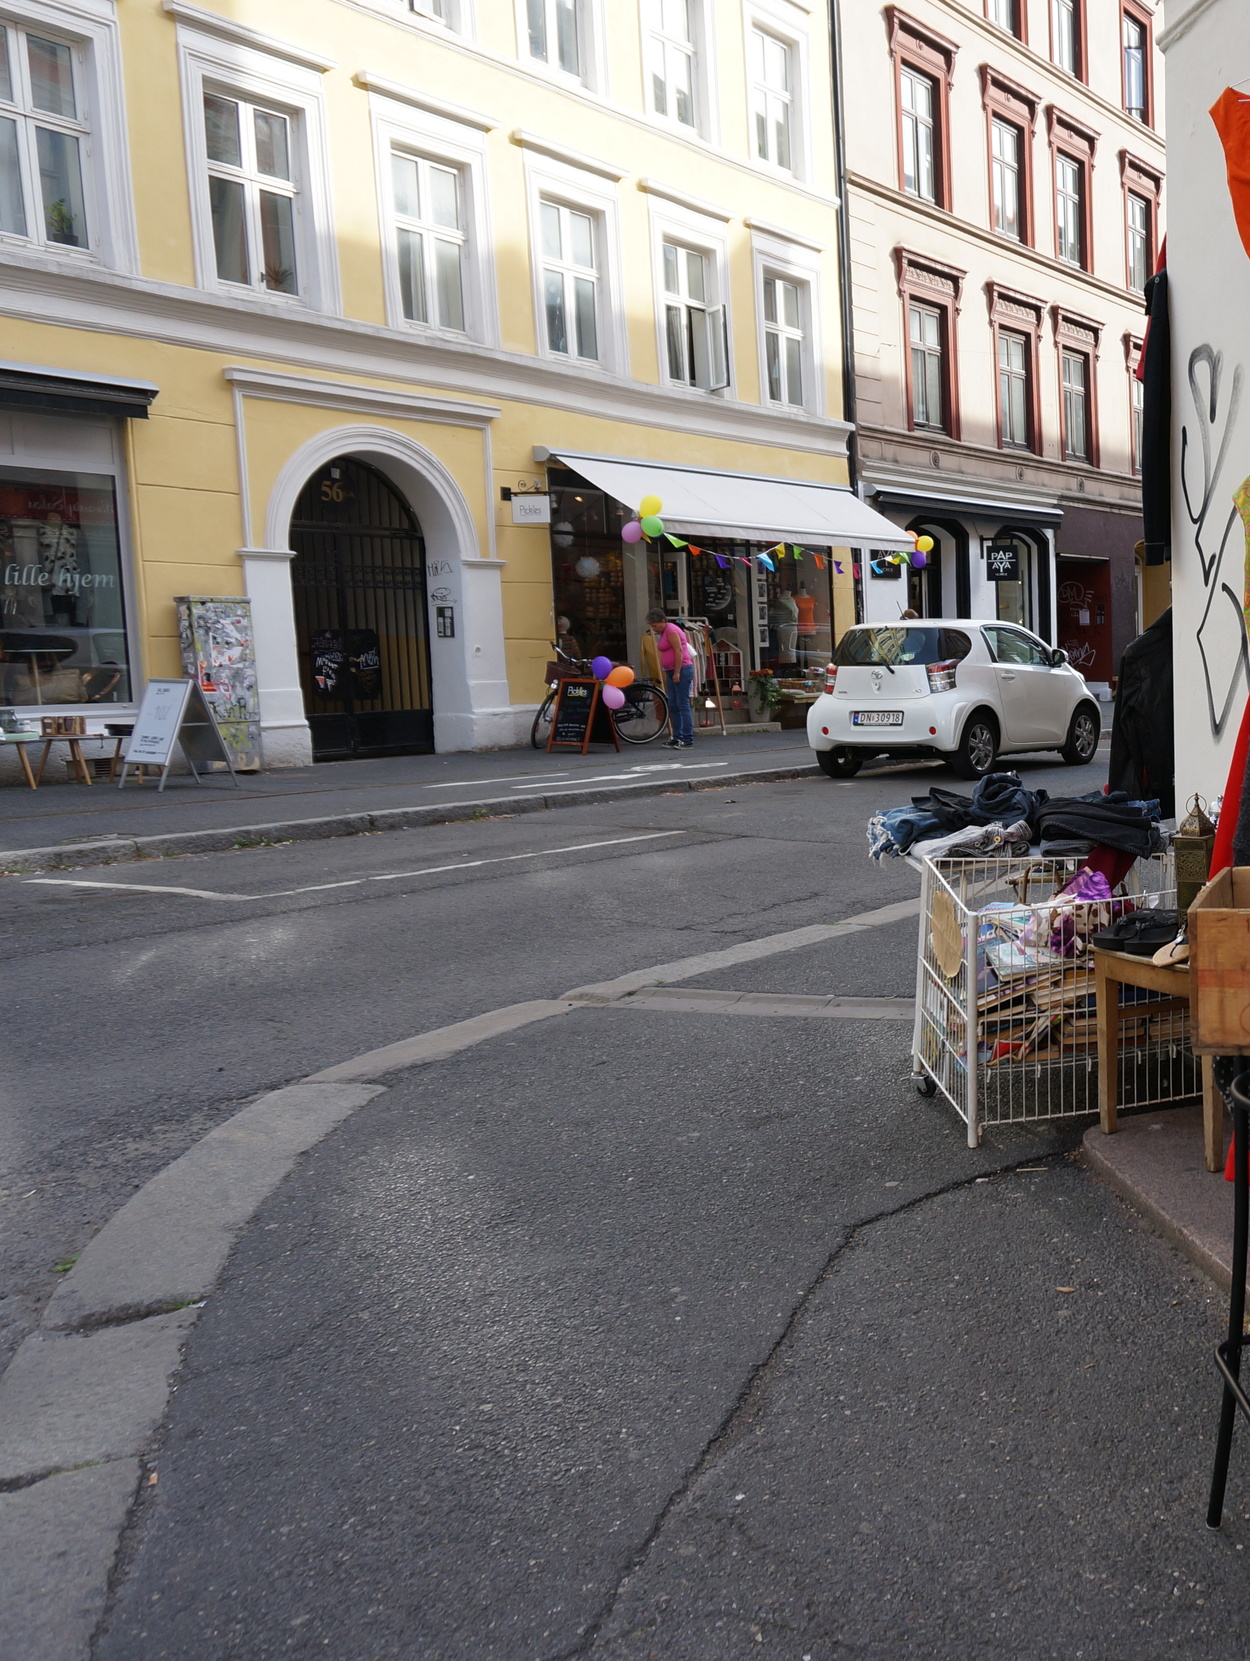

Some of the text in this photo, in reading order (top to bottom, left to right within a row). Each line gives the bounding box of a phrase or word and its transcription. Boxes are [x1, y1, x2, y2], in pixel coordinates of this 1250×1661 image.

[321, 480, 343, 502] 56
[991, 550, 1013, 560] PAP
[992, 561, 1011, 573] AYA
[4, 563, 116, 594] lille hjem
[860, 713, 901, 723] DN 30918
